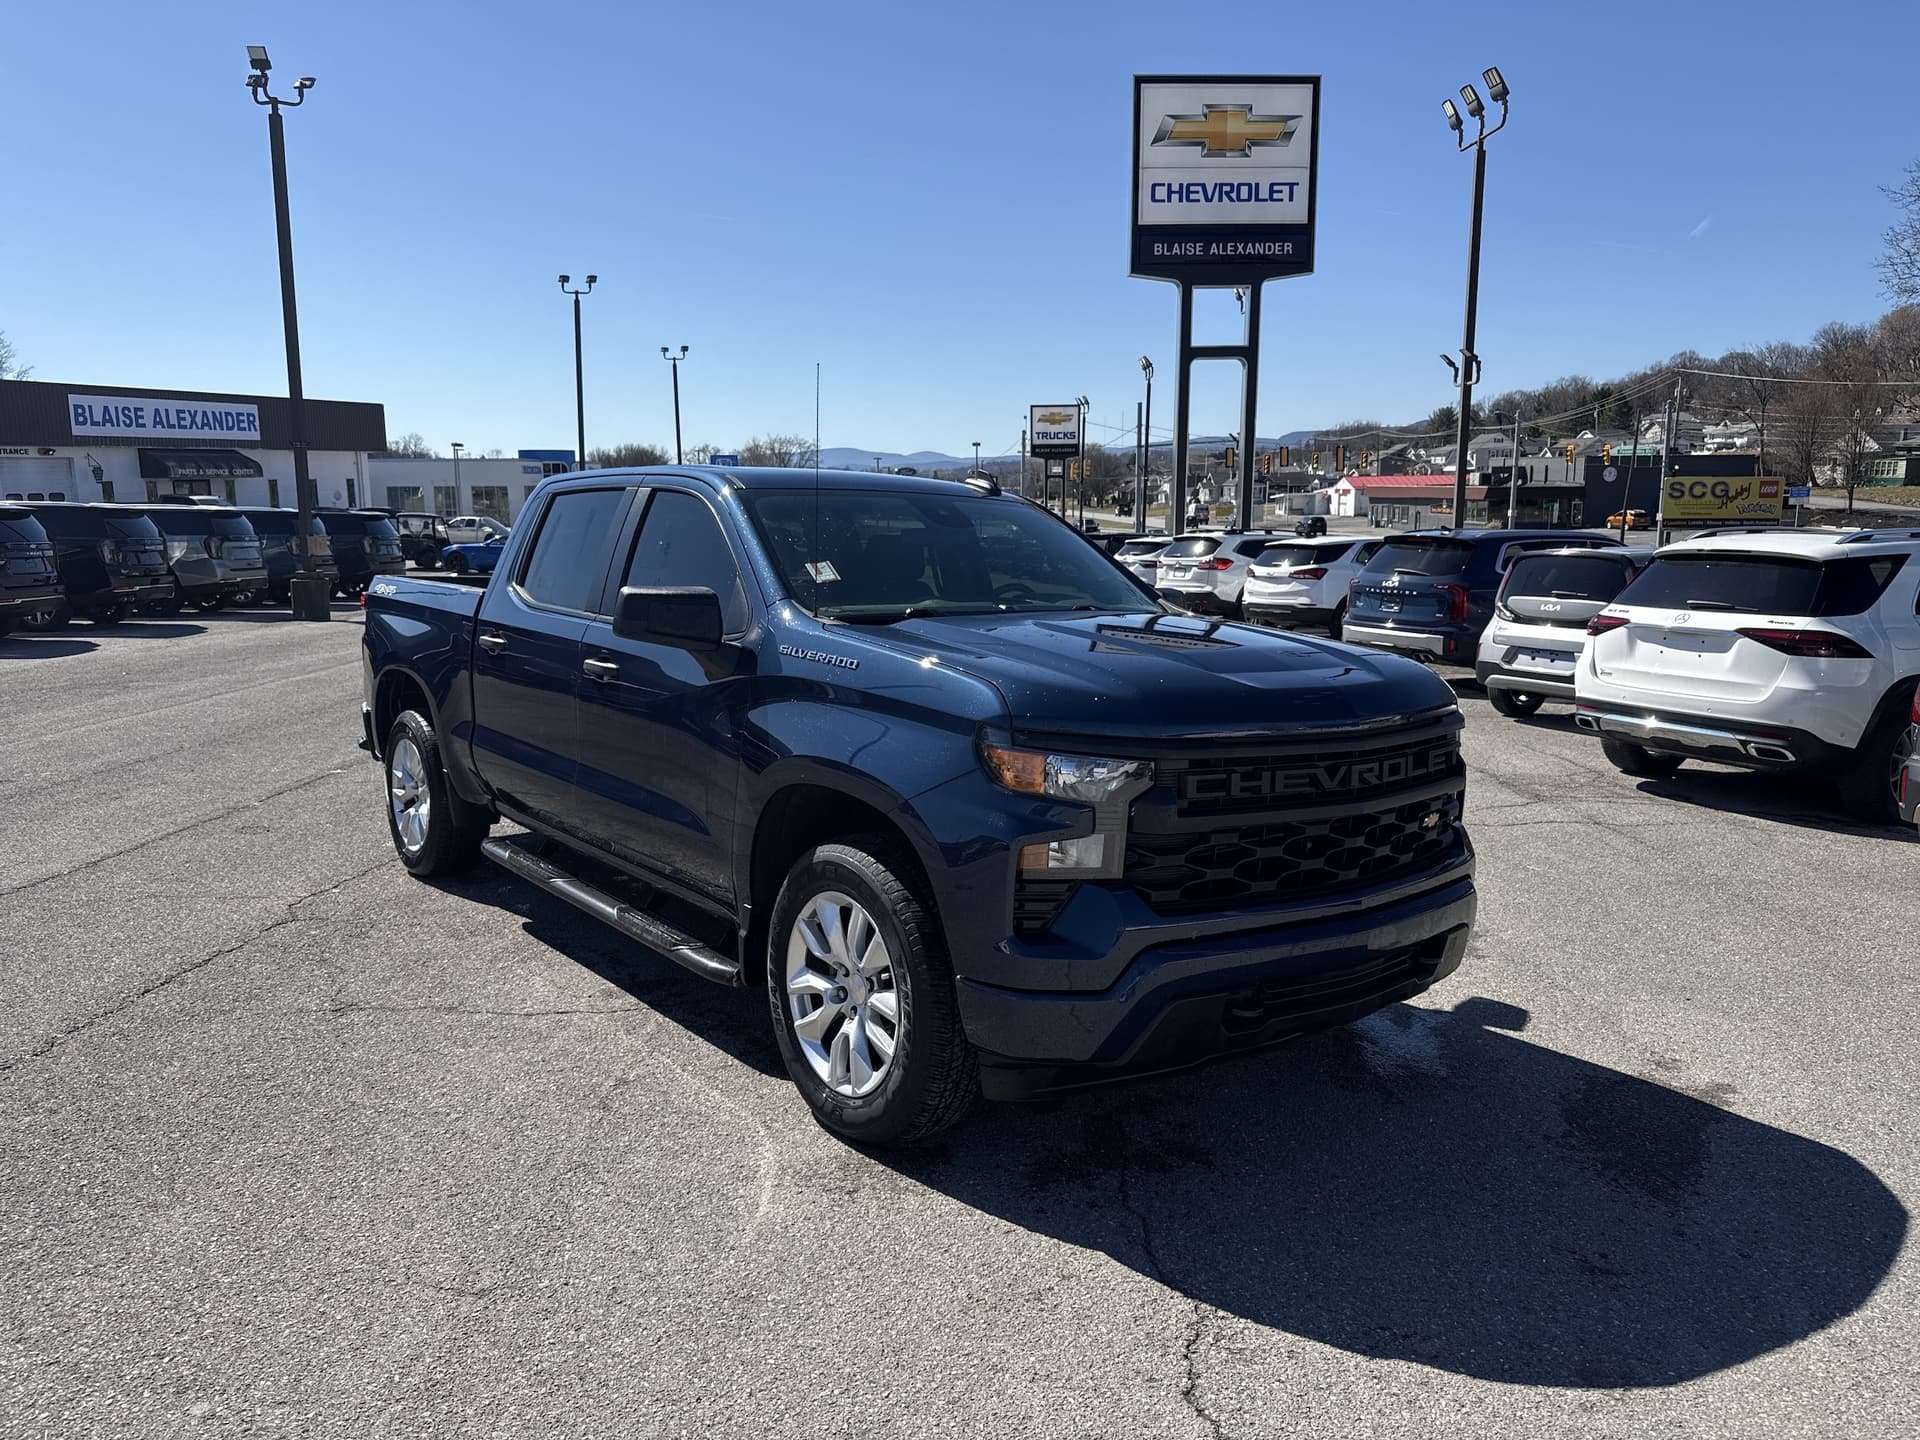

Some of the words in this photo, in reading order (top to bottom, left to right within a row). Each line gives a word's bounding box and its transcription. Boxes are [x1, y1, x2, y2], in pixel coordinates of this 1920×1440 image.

[1150, 182, 1299, 203] CHEVROLET
[1153, 242, 1204, 256] BLAISE
[1209, 241, 1293, 256] ALEXANDER
[73, 404, 146, 428] BLAISE
[153, 408, 258, 432] ALEXANDER
[1035, 431, 1076, 440] TRUCKS
[1667, 480, 1730, 500] SCG
[1760, 485, 1778, 494] LEGO
[779, 644, 861, 670] SILVERADO
